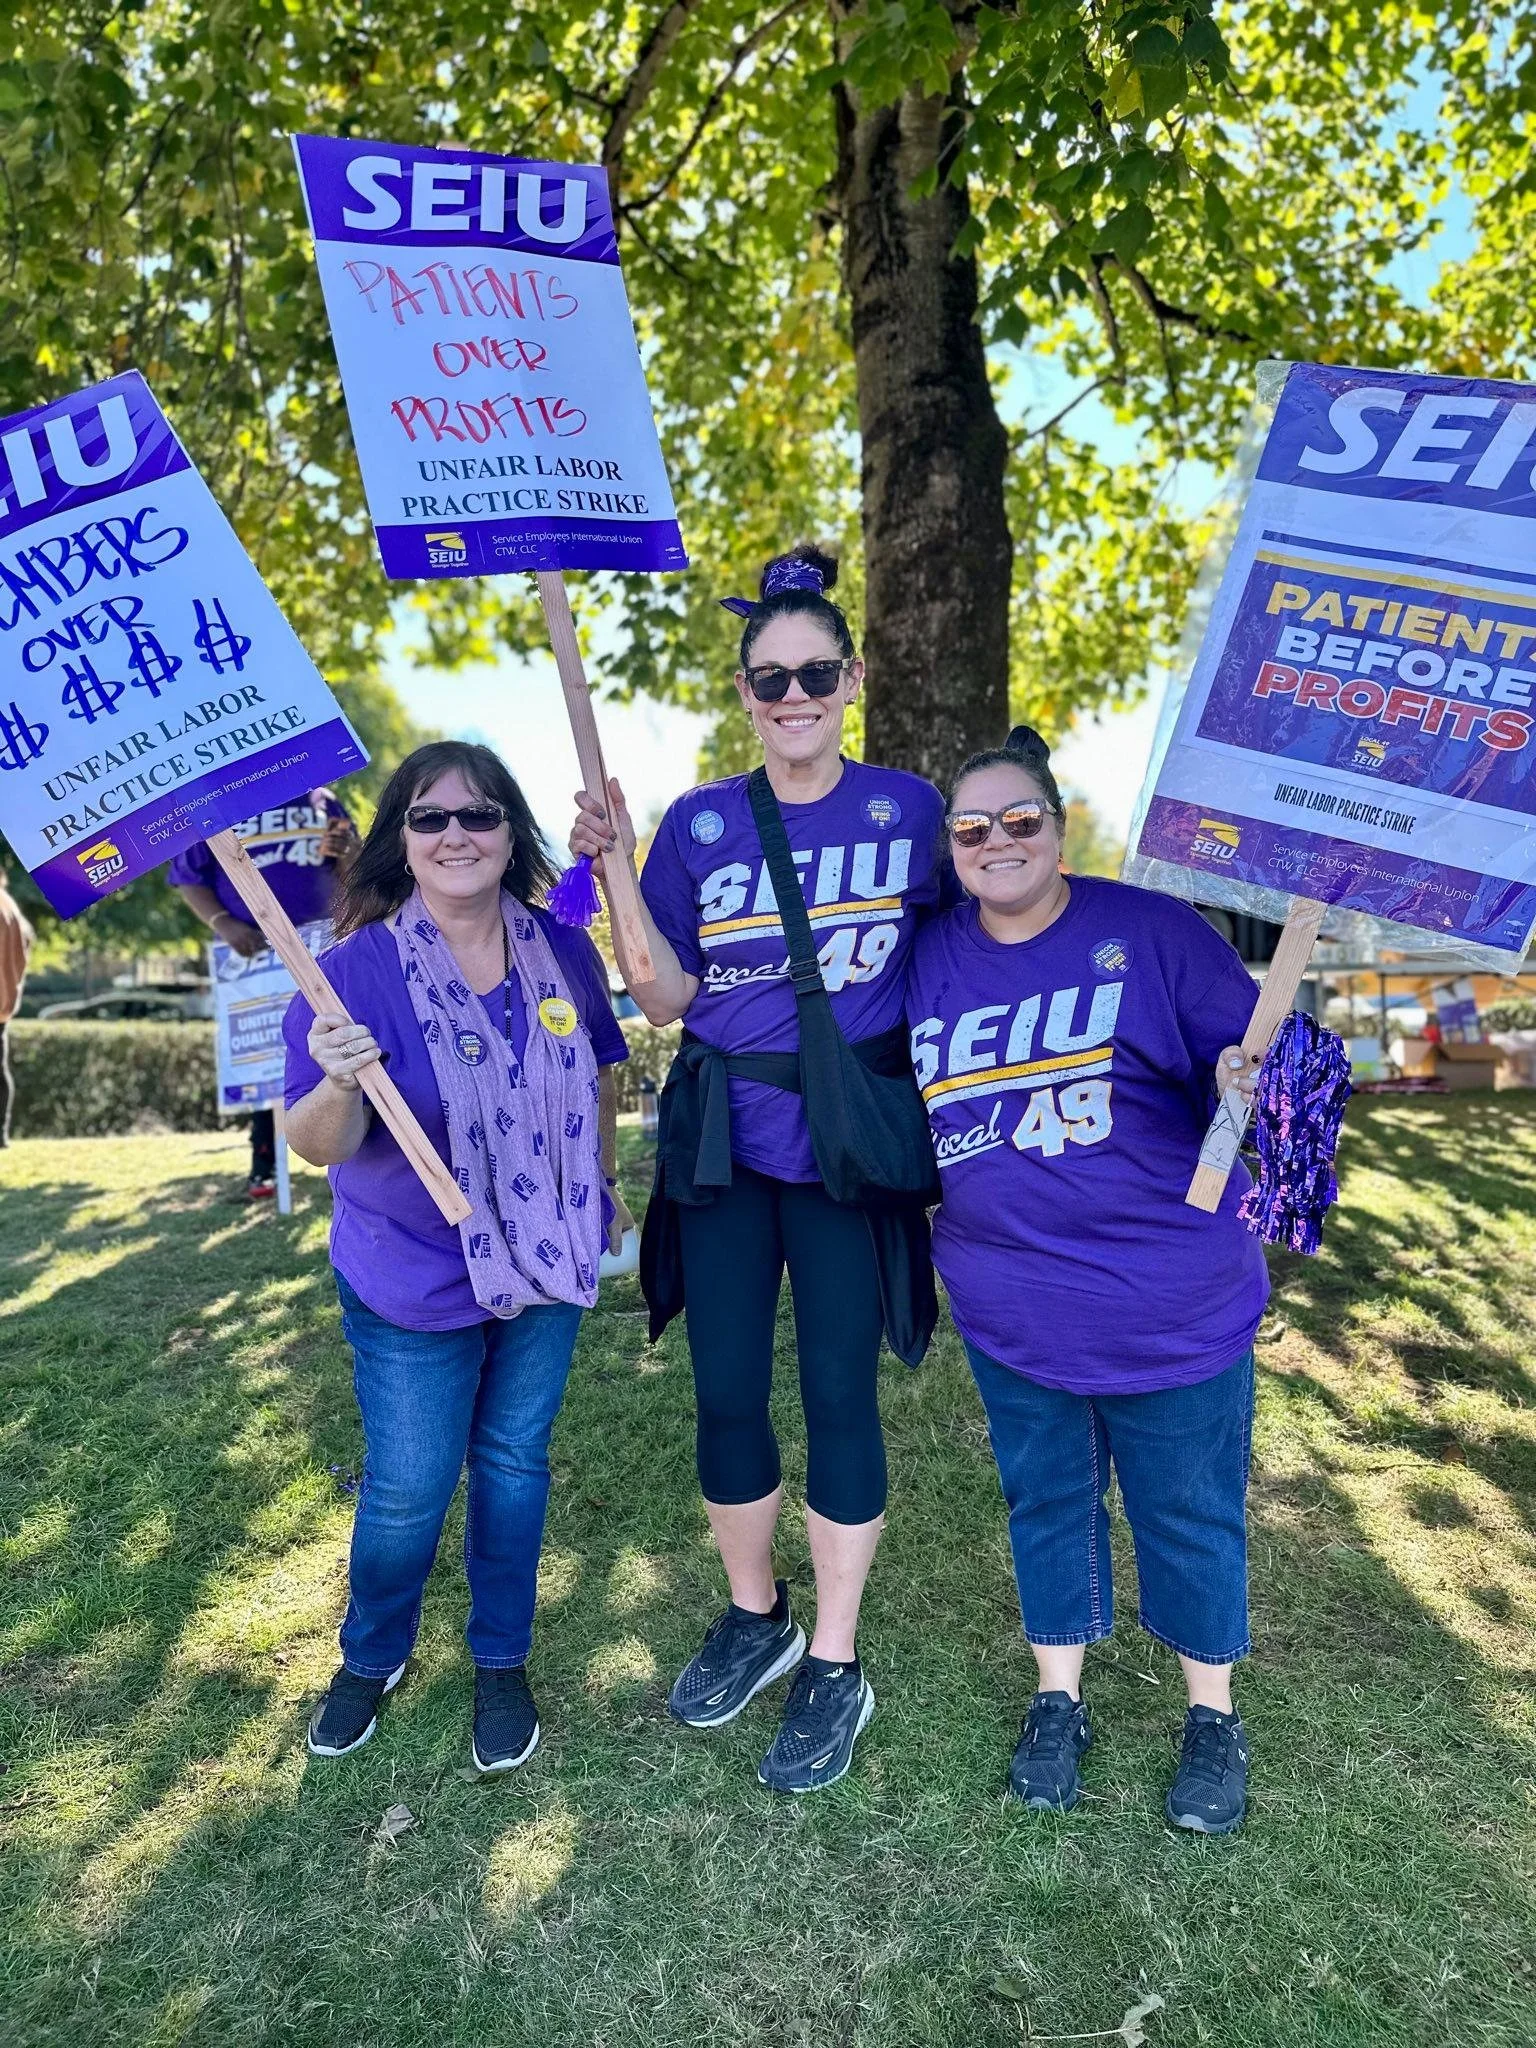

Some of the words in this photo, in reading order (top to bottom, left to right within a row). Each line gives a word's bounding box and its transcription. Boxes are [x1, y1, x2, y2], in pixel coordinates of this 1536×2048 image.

[343, 156, 590, 243] SEIU
[344, 261, 579, 325] PATIENTS
[433, 336, 551, 378] OVER
[391, 393, 587, 443] PROFITS
[1298, 387, 1536, 492] SEI
[0, 395, 138, 517] IU
[418, 456, 530, 481] UNFAIR
[535, 455, 623, 481] LABOR
[402, 489, 551, 517] PRACTICE
[557, 489, 649, 514] STRIKE
[492, 534, 523, 545] Service
[525, 532, 570, 545] Employees
[571, 531, 618, 544] International
[619, 534, 643, 544] Union
[519, 545, 538, 554] CLC
[429, 550, 467, 563] SEIU
[1265, 581, 1536, 659] PATIENT
[22, 596, 155, 672] OVER
[1275, 625, 1536, 707] BEFORE
[1253, 661, 1536, 751] PROFITS
[42, 731, 158, 801] UNFAIR
[155, 684, 266, 742] LABOR
[1360, 736, 1380, 745] LOCAL
[1351, 752, 1384, 768] SEIU
[40, 754, 192, 849] PRACTICE
[194, 705, 306, 766] STRIKE
[142, 812, 174, 834] Service
[174, 786, 224, 815] Employees
[223, 764, 280, 793] International
[280, 751, 309, 768] Union
[1273, 783, 1305, 807] UNFAIR
[1305, 791, 1337, 814] LABOR
[1337, 798, 1383, 827] PRACTICE
[1380, 809, 1417, 835] STRIKE
[173, 817, 193, 832] CLC
[1190, 839, 1237, 859] SEIU
[88, 854, 124, 885] SEIU
[1272, 843, 1308, 860] Service
[1310, 852, 1368, 876] Employees
[1371, 867, 1443, 895] International
[1444, 883, 1480, 903] Union
[1296, 864, 1318, 878] CLC
[419, 920, 440, 936] SEIU
[514, 917, 525, 940] SEIU
[817, 923, 899, 992] 49
[1093, 943, 1113, 958] UNION
[1095, 945, 1120, 964] STRONG
[449, 980, 471, 998] SEIU
[238, 1011, 286, 1031] UNITE
[430, 1020, 440, 1045] SEIU
[232, 1030, 285, 1050] QUALIT
[911, 982, 1123, 1091] SEIU
[497, 1108, 516, 1127] SEIU
[565, 1111, 576, 1138] SEIU
[931, 1101, 1002, 1158] ocal
[1012, 1080, 1113, 1157] 49
[461, 1167, 469, 1194] SEIU
[517, 1173, 539, 1193] SEIU
[569, 1180, 580, 1208] SEIU
[483, 1233, 492, 1258] SEIU
[509, 1220, 518, 1246] SEIU
[540, 1239, 563, 1258] SEIU
[503, 1294, 512, 1309] EIU
